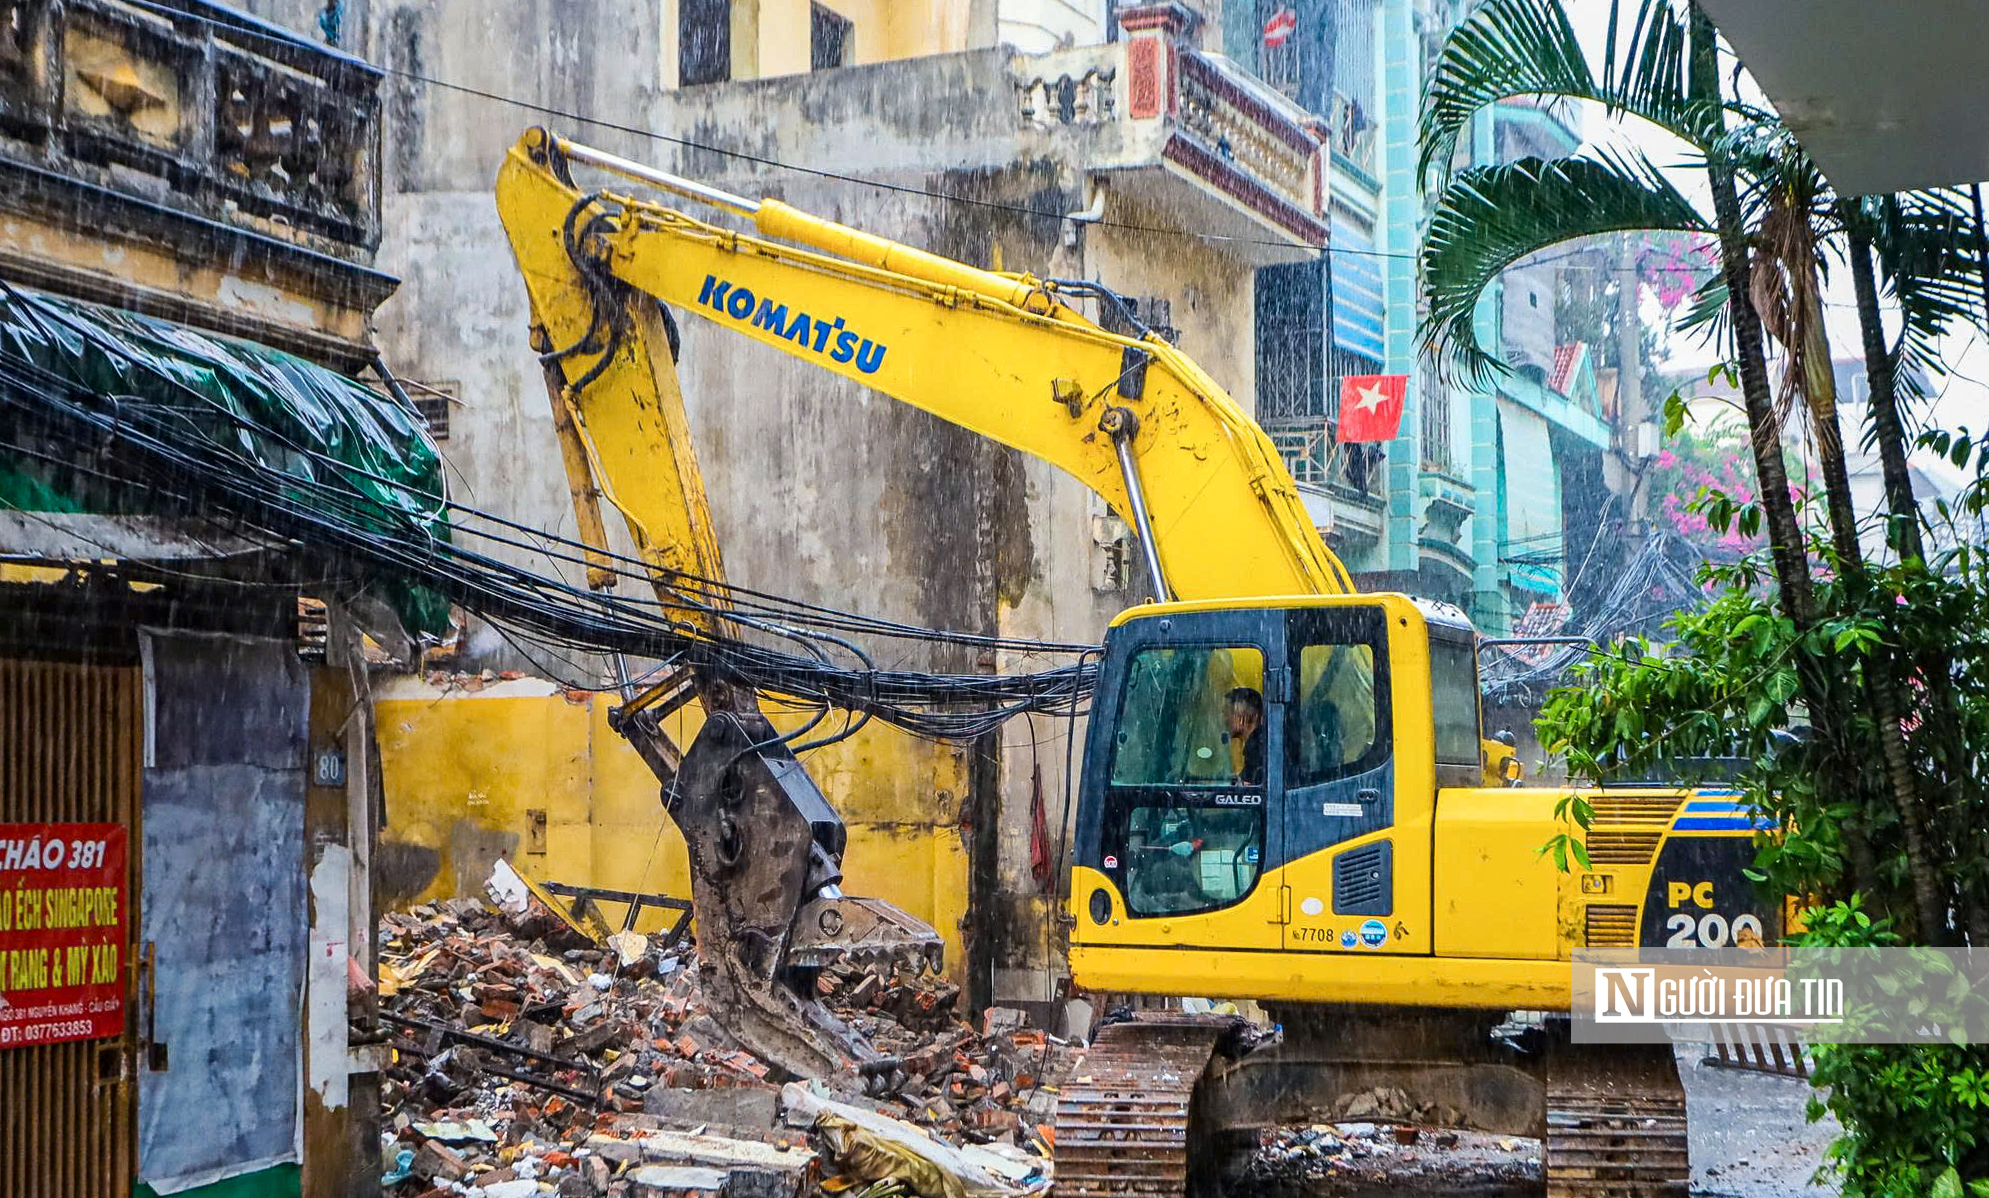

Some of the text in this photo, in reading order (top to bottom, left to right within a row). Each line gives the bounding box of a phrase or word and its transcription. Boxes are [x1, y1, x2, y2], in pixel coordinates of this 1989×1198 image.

[698, 274, 887, 374] KOMATSU
[319, 755, 339, 779] 80
[1215, 794, 1262, 805] GALEO
[68, 840, 106, 869] 381
[45, 886, 118, 929] SINGAPORE
[1668, 881, 1714, 909] PC
[1301, 928, 1334, 942] 7708
[1666, 913, 1763, 949] 200
[11, 948, 48, 991] RANG
[53, 947, 62, 988] &
[91, 936, 118, 984] XÀO
[1, 1019, 93, 1043] ĐT: 0377633853
